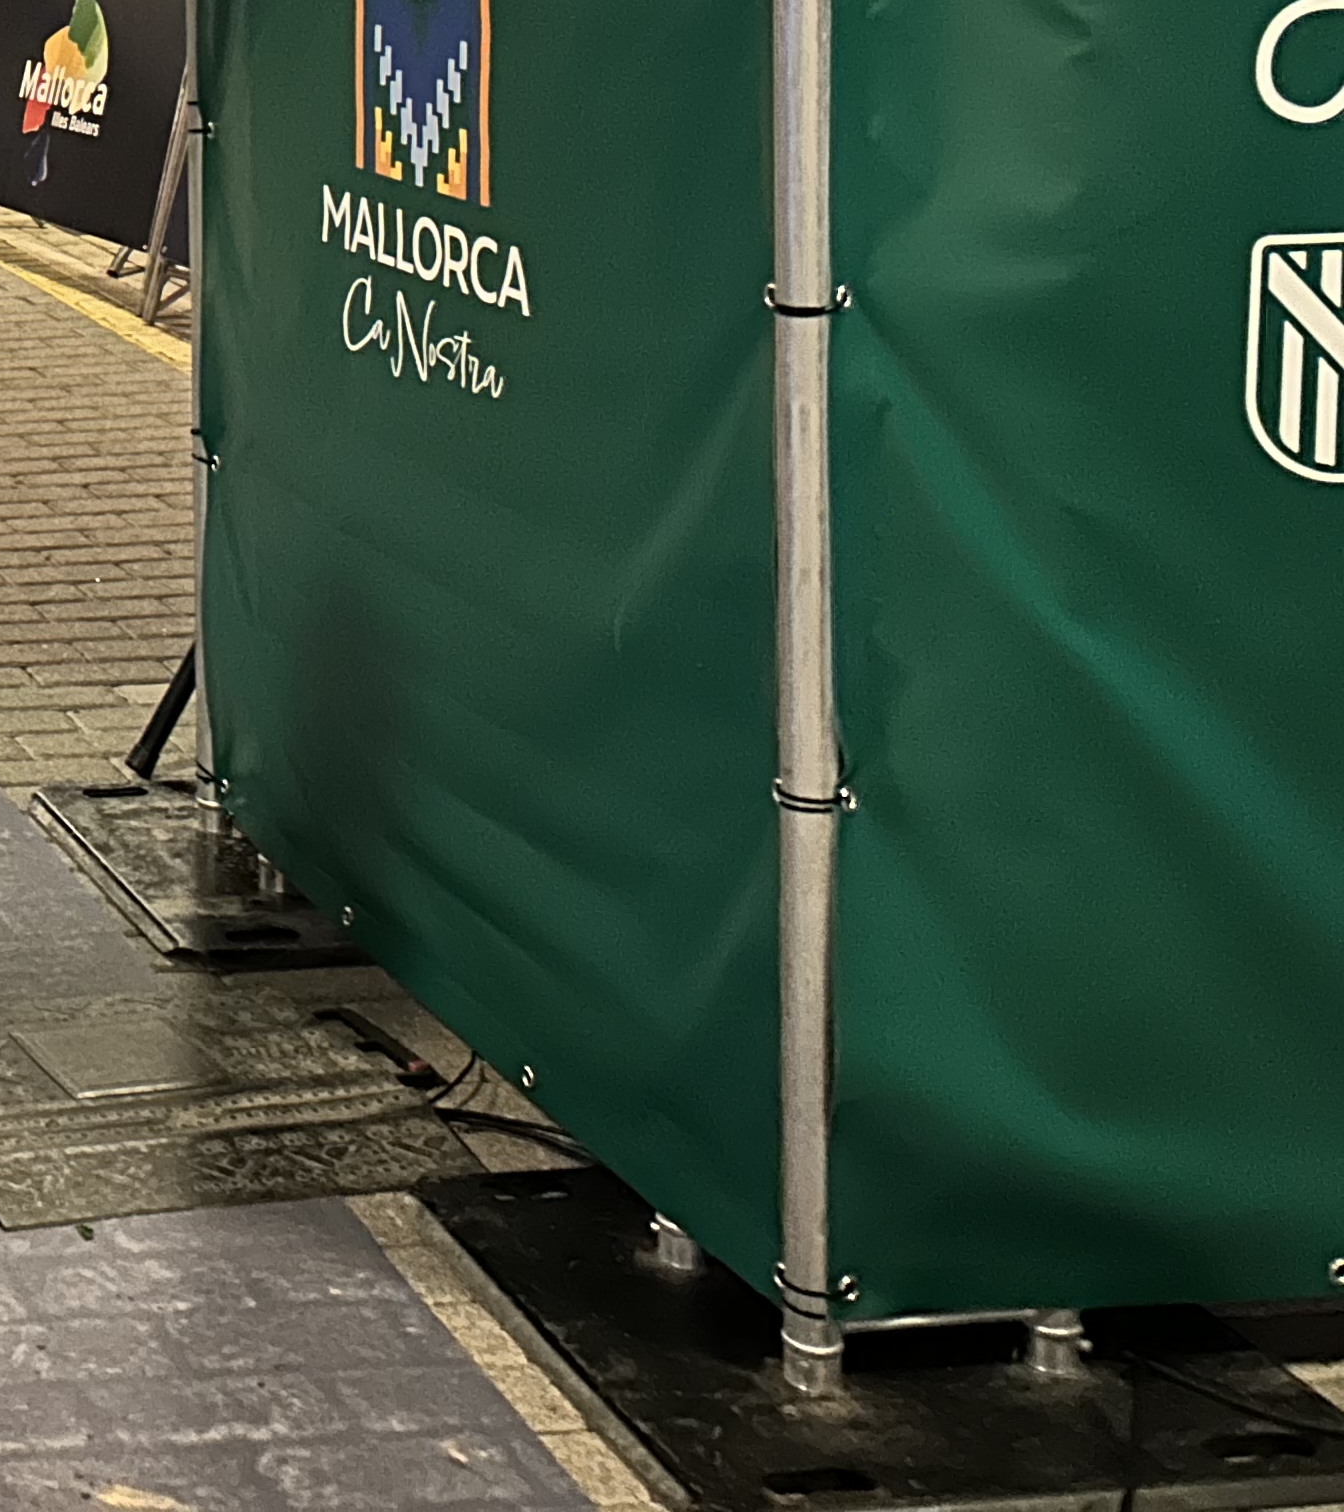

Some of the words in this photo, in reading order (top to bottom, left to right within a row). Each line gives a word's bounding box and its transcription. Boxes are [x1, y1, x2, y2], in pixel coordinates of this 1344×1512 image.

[18, 59, 108, 116] Mallorca
[69, 115, 100, 137] Balears
[321, 184, 531, 317] MALLORCA
[342, 275, 391, 352] Ca
[390, 290, 505, 399] Nostra
